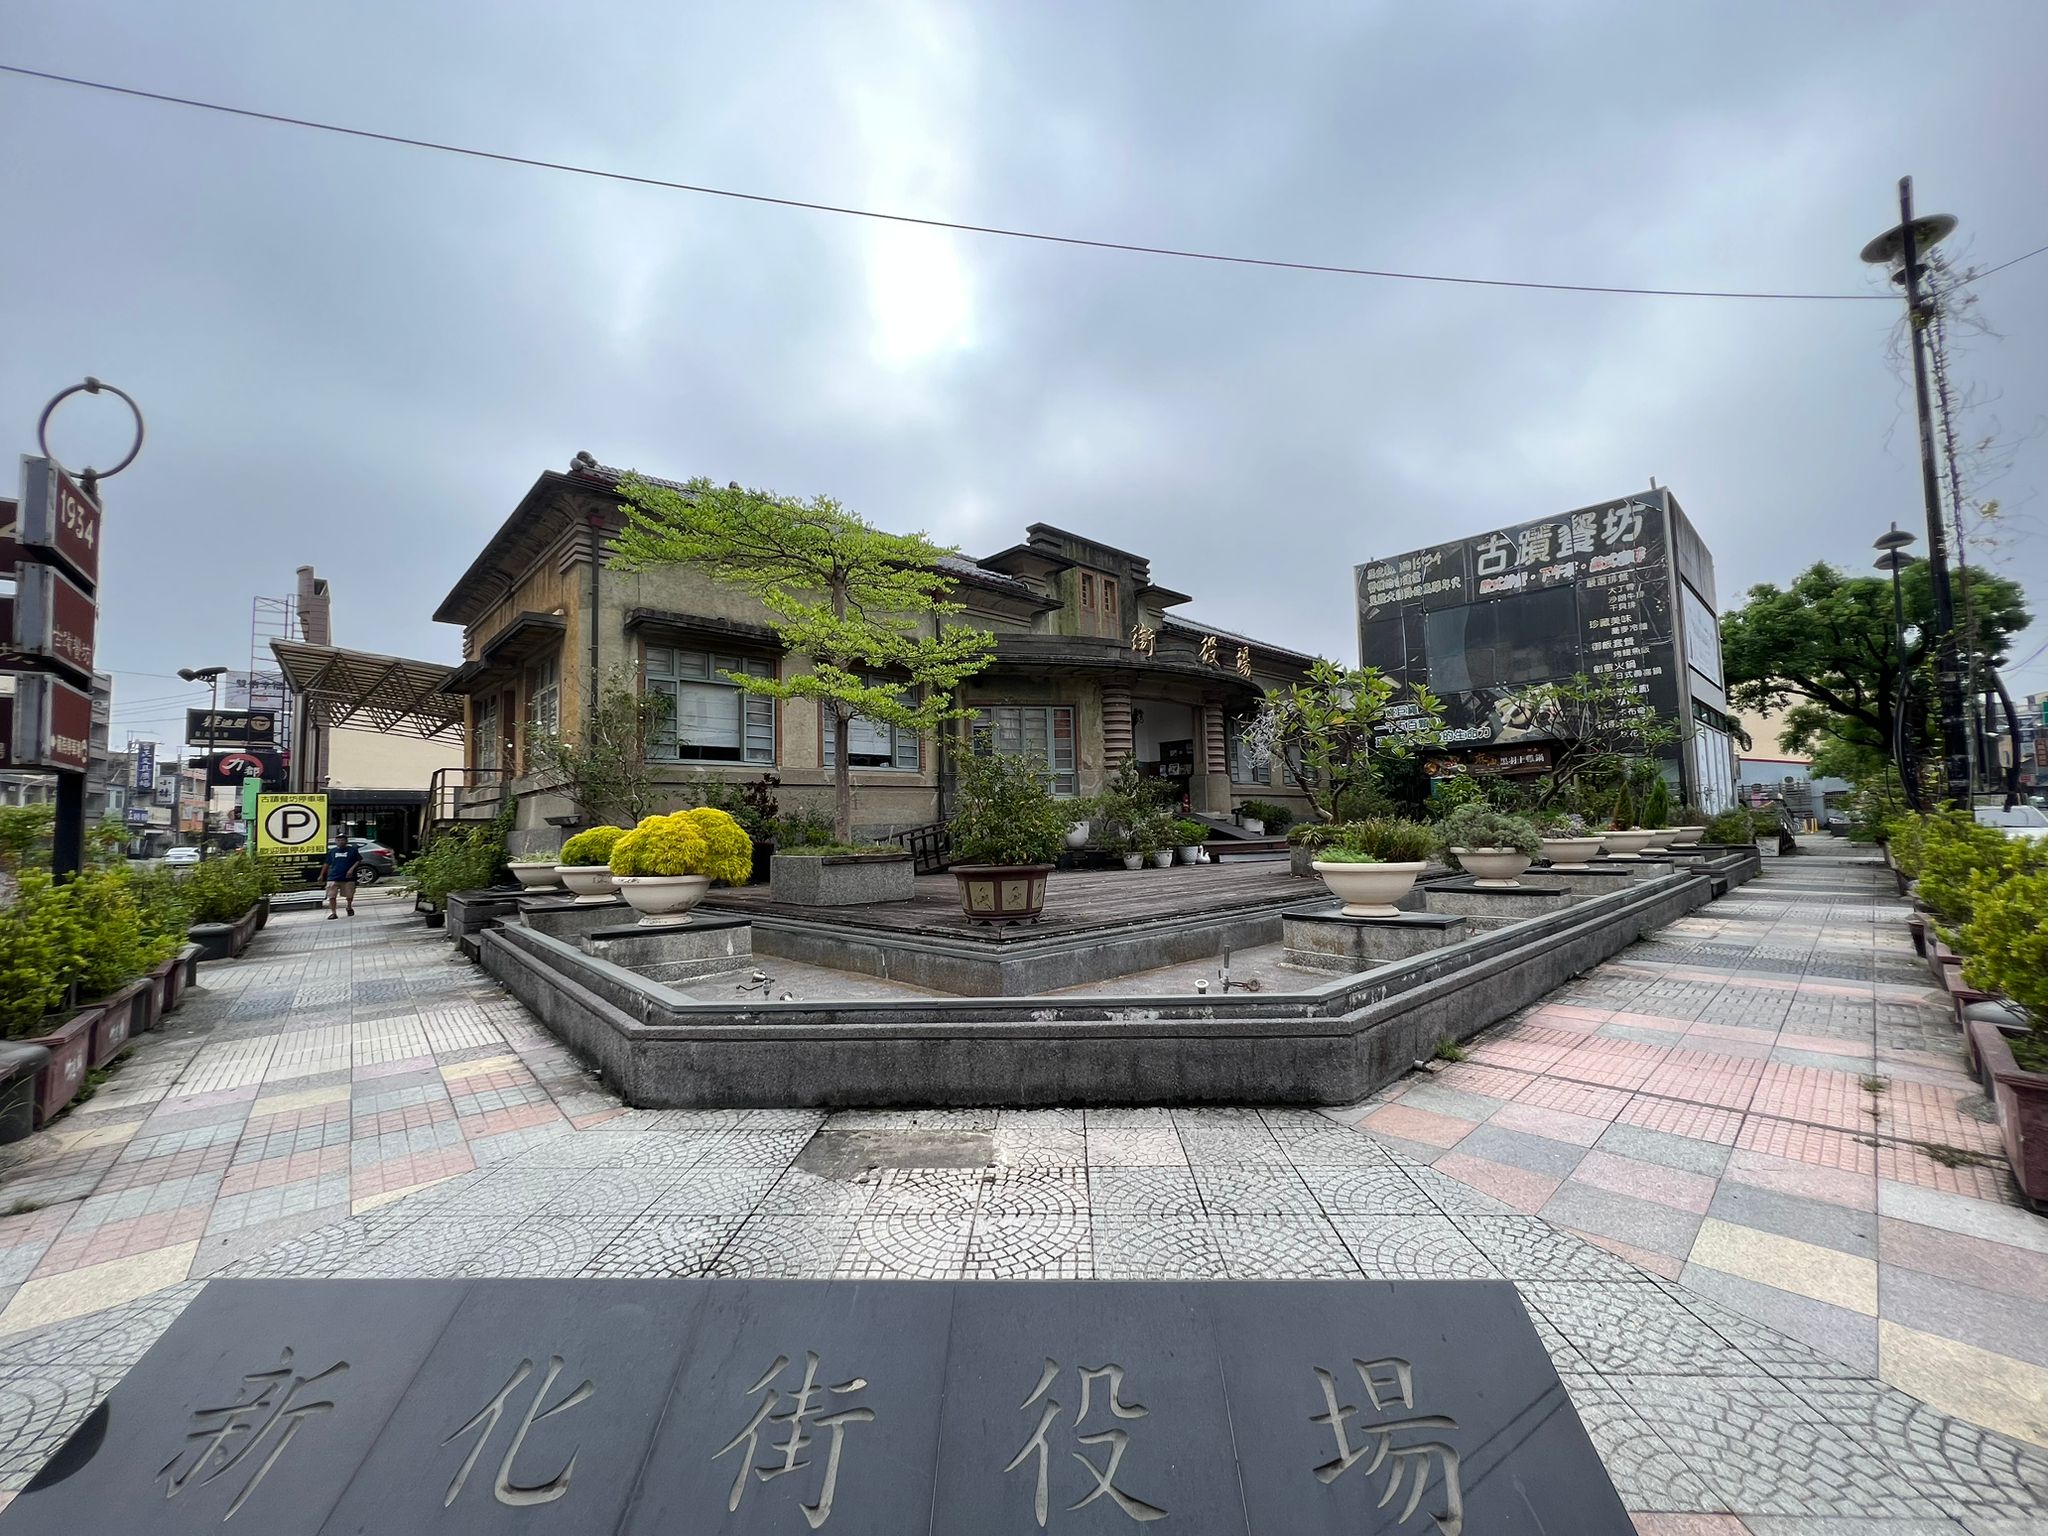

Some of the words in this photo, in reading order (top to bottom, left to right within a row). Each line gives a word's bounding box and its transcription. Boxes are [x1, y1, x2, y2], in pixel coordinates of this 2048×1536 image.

[61, 489, 94, 550] 1934
[281, 810, 311, 839] P
[154, 1346, 1465, 1536] 新化街役場
